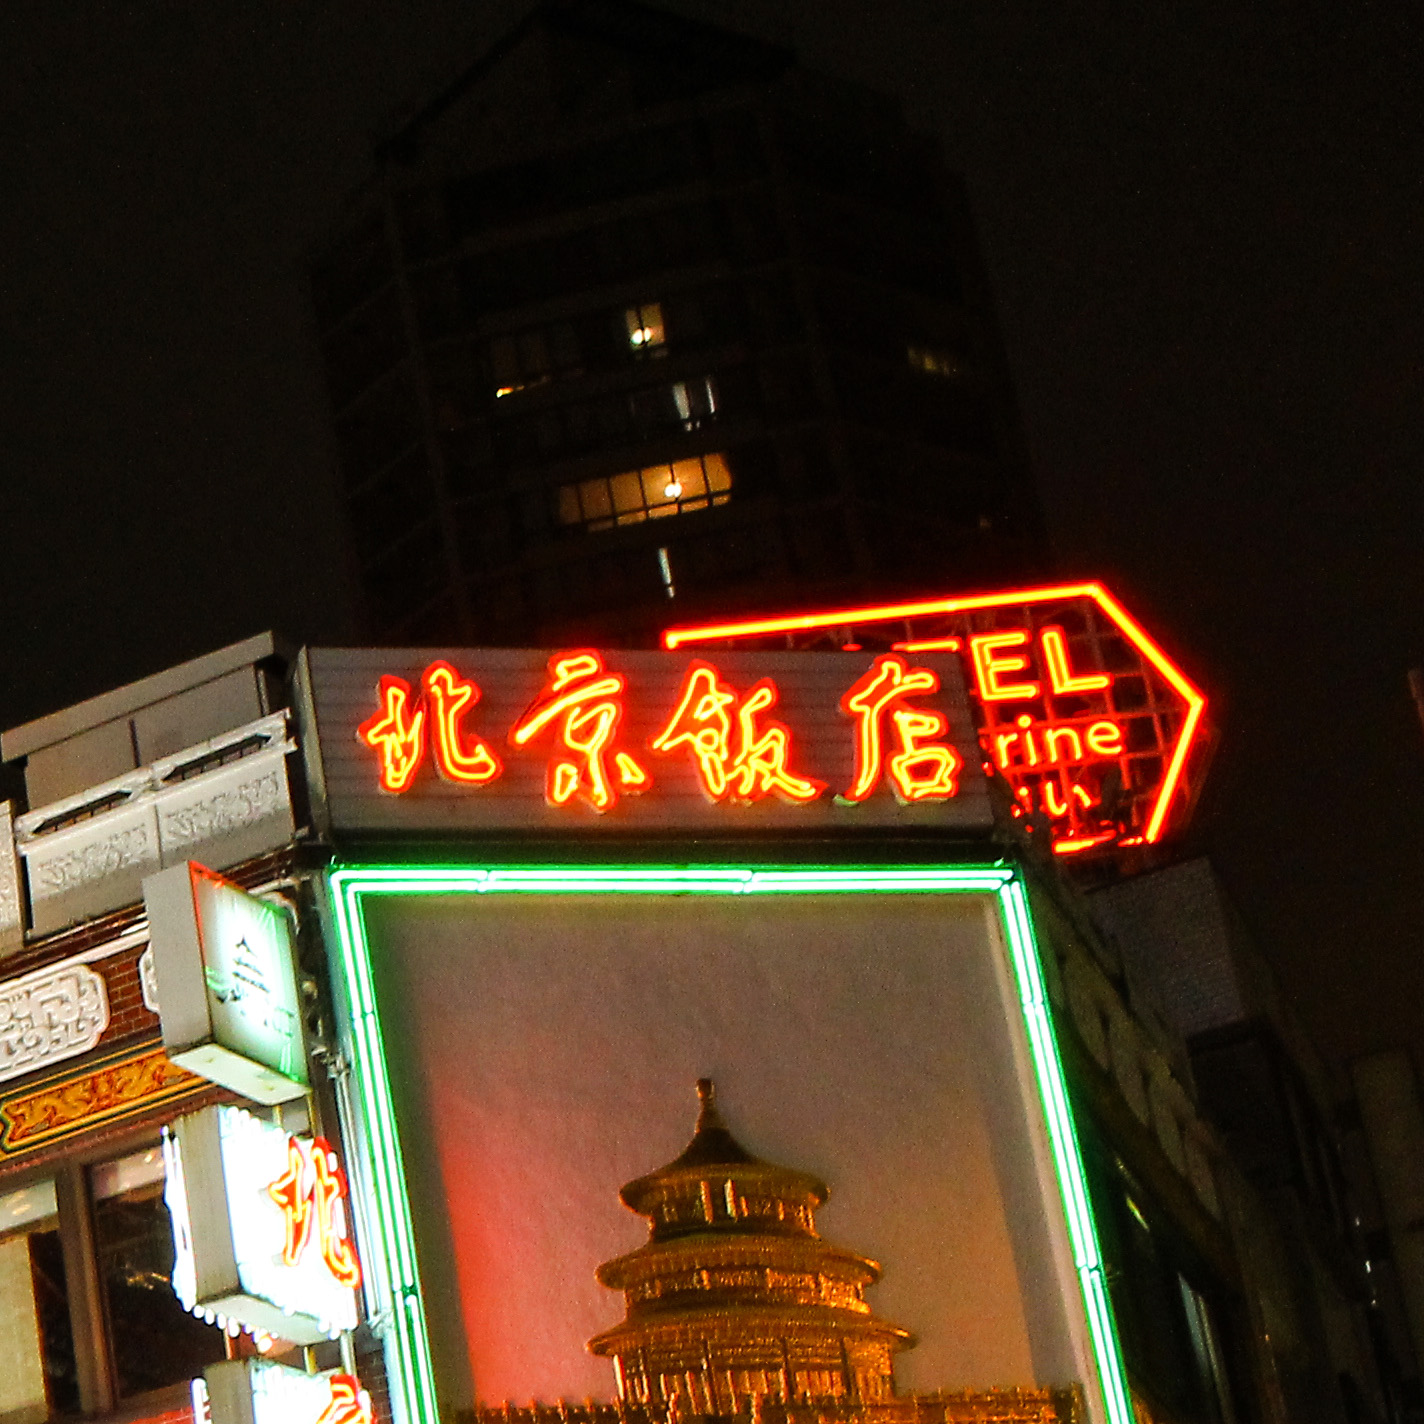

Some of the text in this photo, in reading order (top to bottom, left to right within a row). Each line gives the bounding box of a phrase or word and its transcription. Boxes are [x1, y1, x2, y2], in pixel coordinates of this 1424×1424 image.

[968, 628, 1113, 701] EL
[358, 648, 958, 814] 北京飯店
[994, 716, 1124, 769] rine
